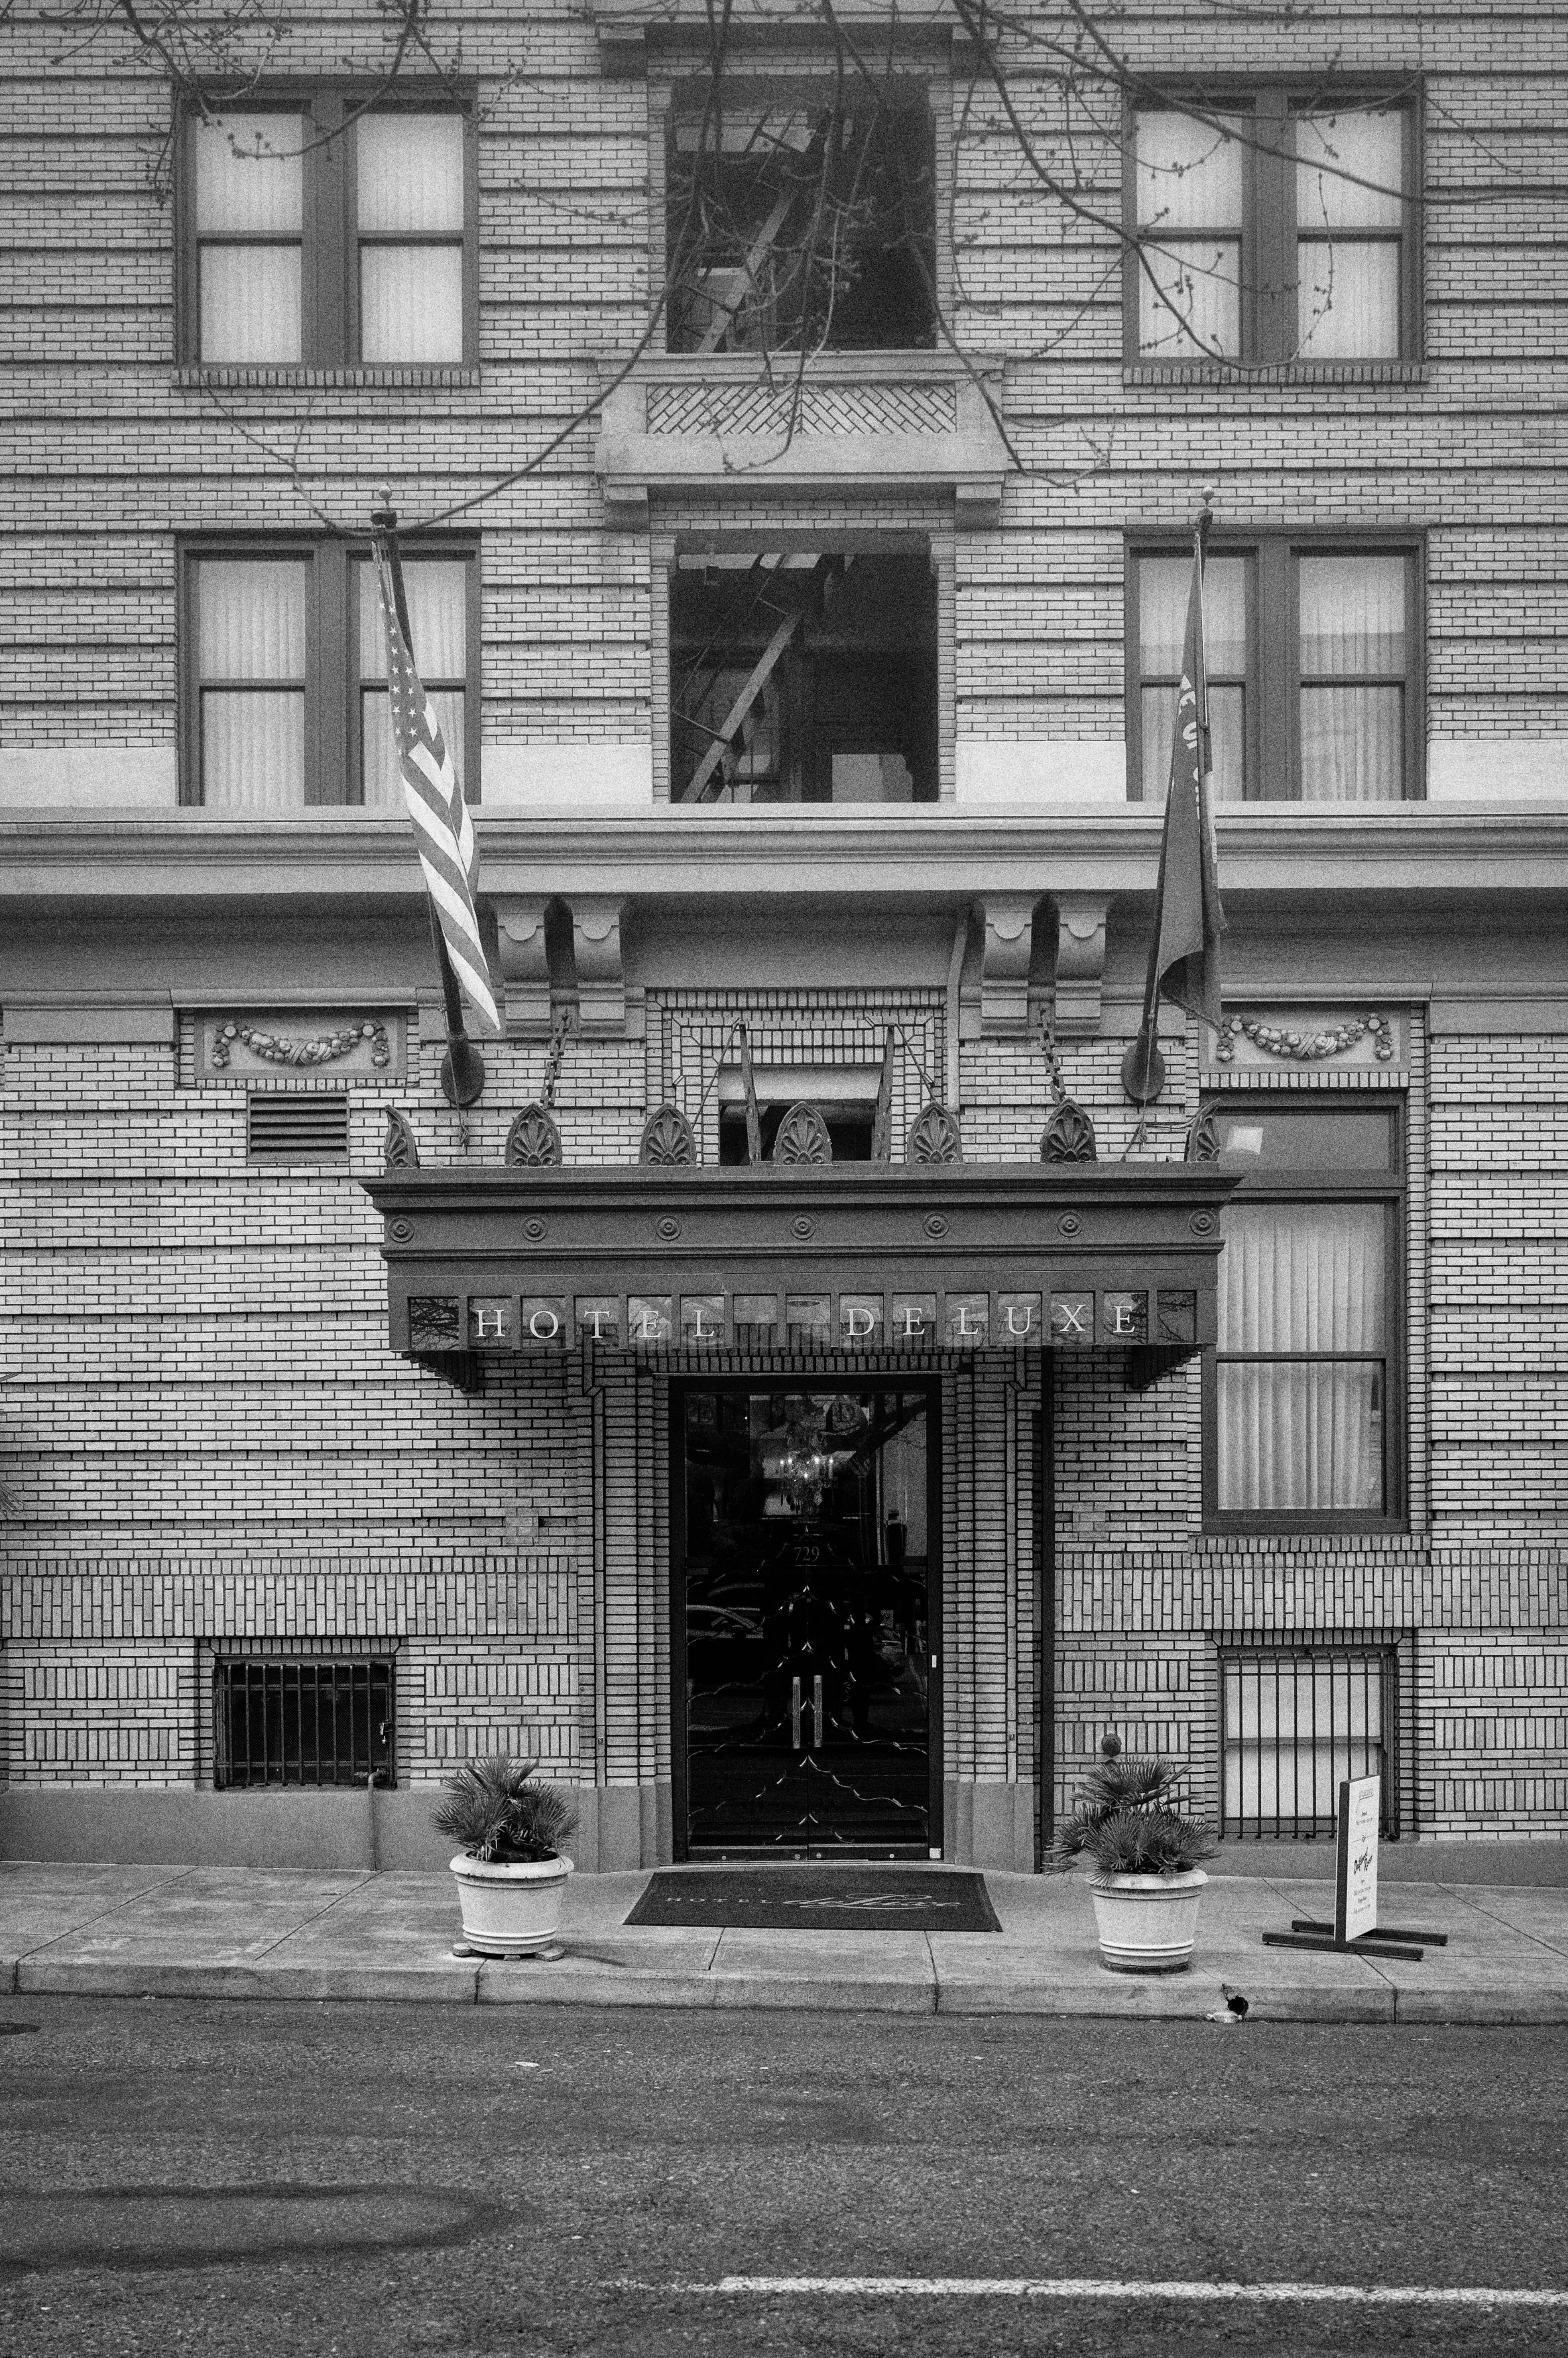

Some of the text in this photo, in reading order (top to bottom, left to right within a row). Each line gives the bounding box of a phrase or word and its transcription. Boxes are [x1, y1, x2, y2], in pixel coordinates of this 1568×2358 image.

[475, 1304, 1135, 1339] HOTEL DELUXE
[793, 1546, 820, 1562] 729
